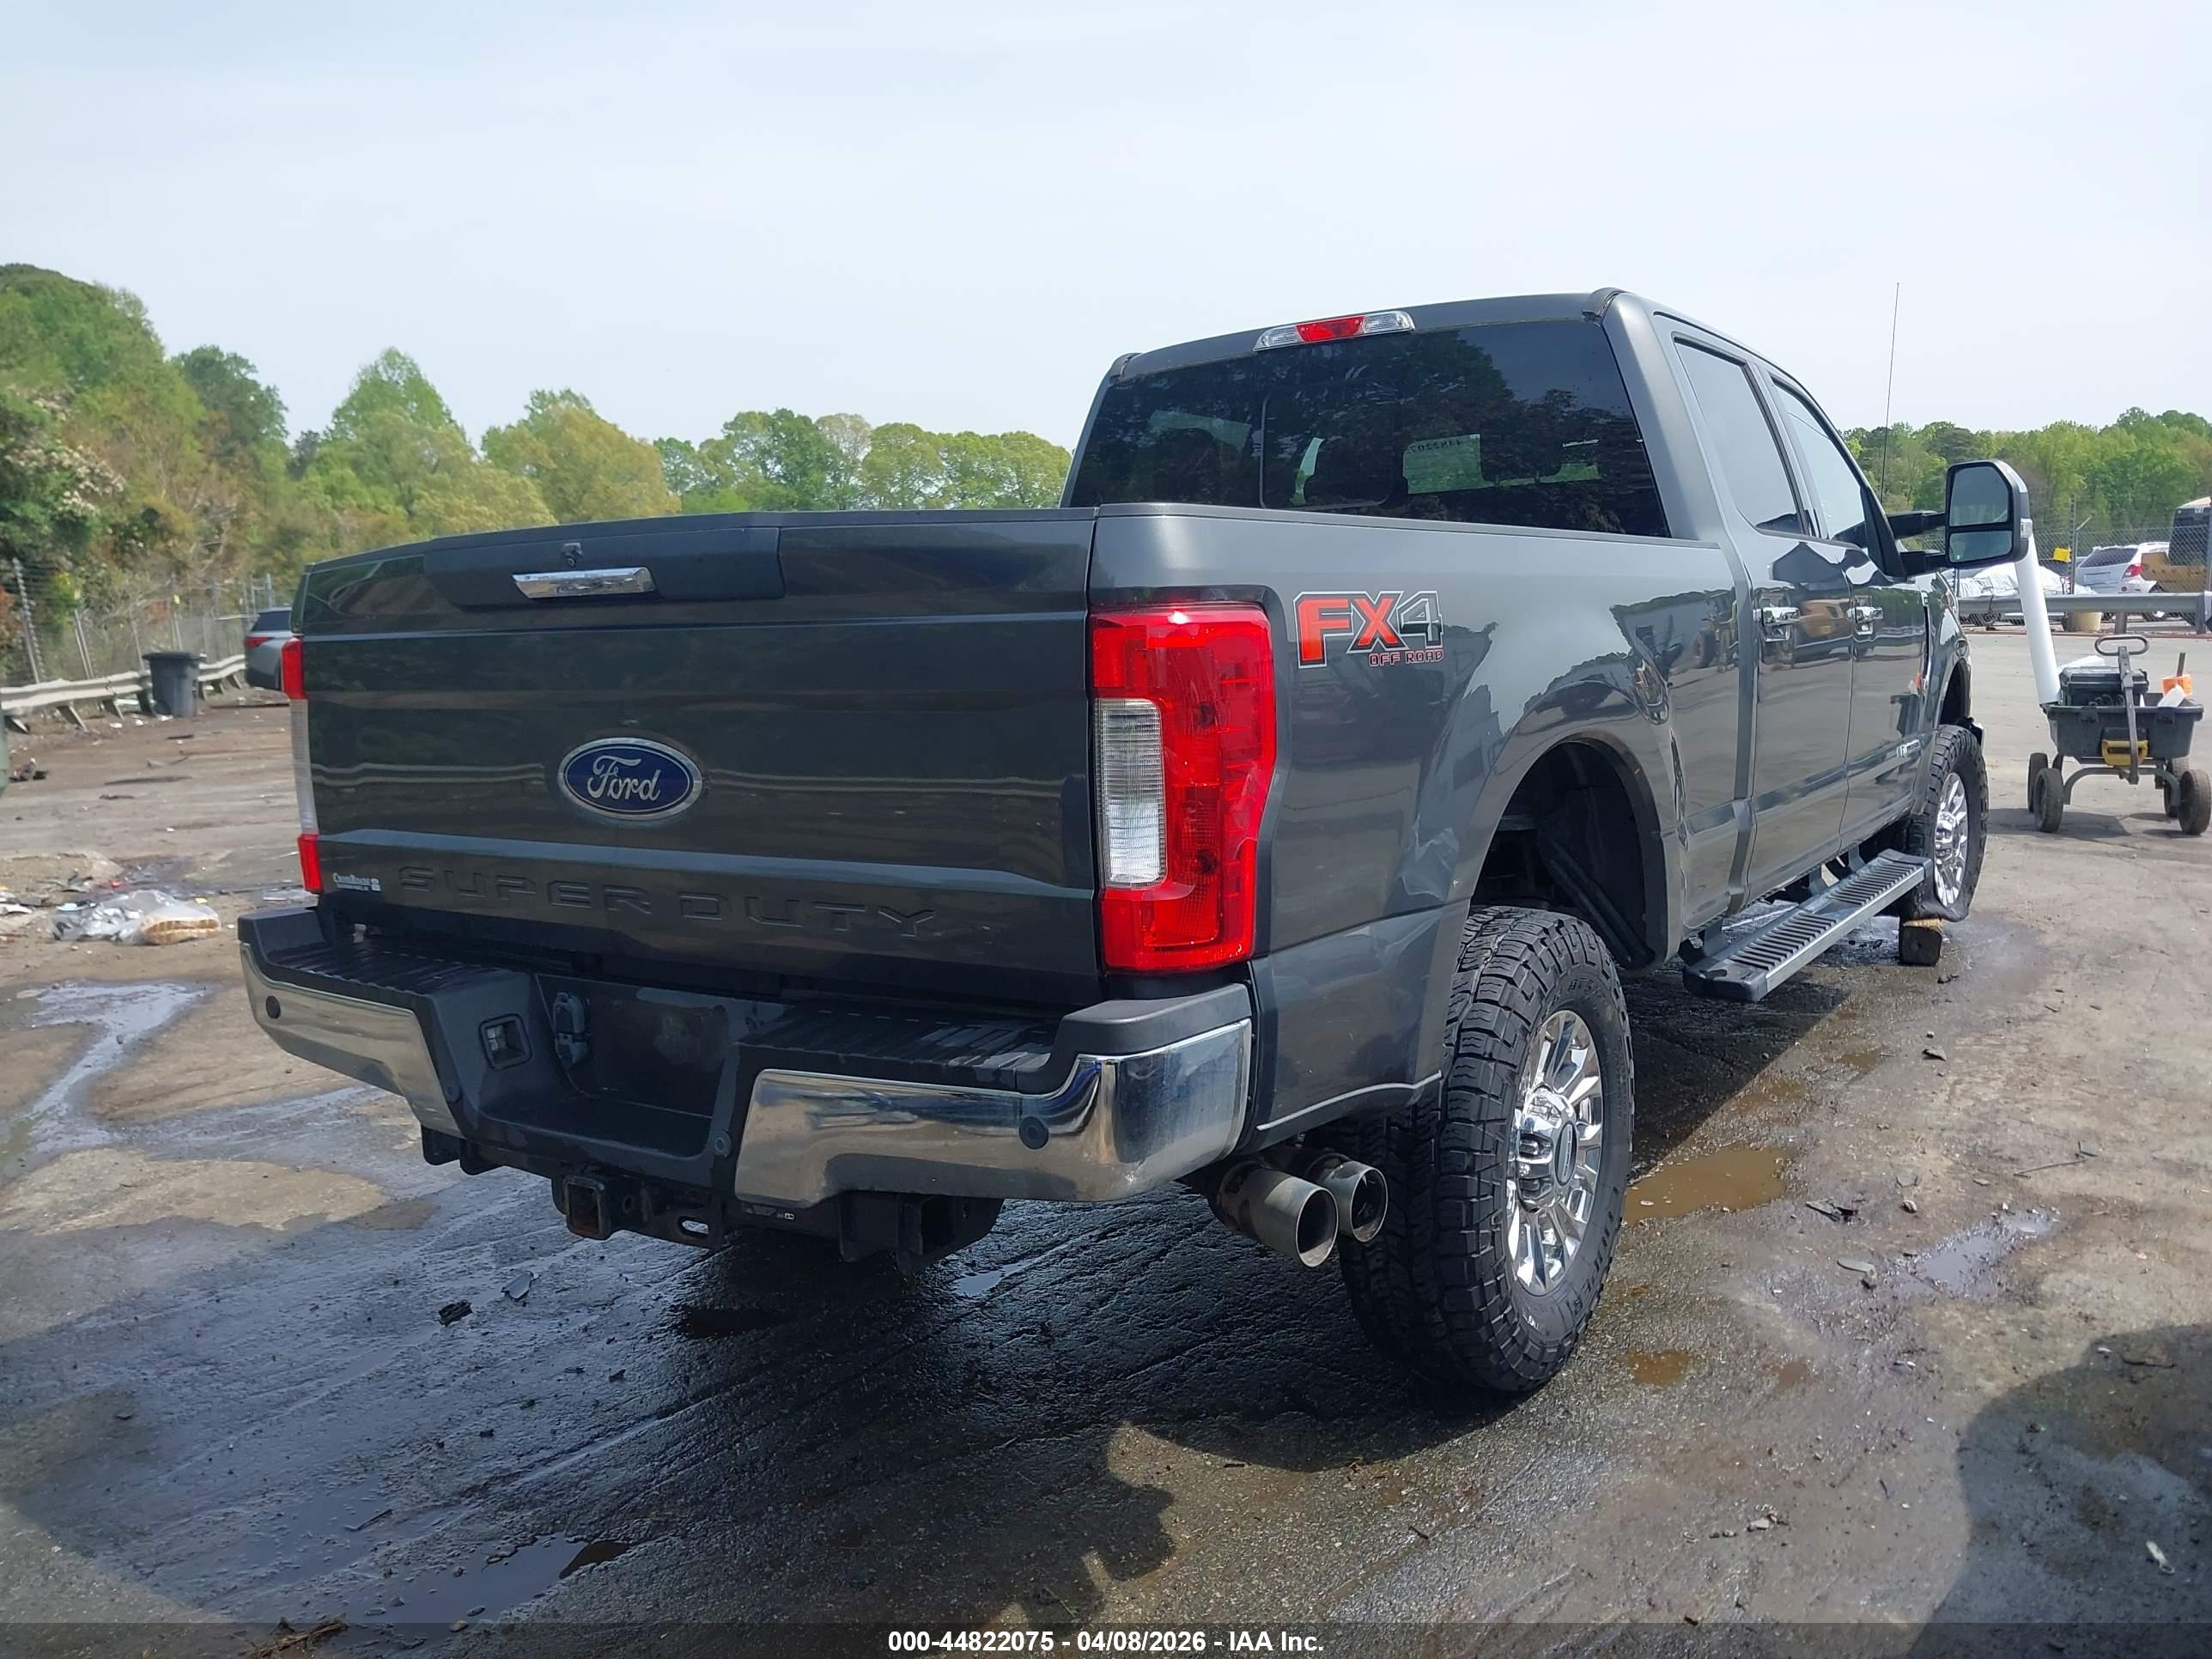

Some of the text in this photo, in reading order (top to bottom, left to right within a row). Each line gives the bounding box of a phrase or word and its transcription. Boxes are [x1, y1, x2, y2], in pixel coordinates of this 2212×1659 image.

[1293, 591, 1443, 669] FX4
[1369, 648, 1444, 667] OFF ROAD
[586, 755, 661, 801] Ford
[398, 866, 935, 937] SUPER DUTY
